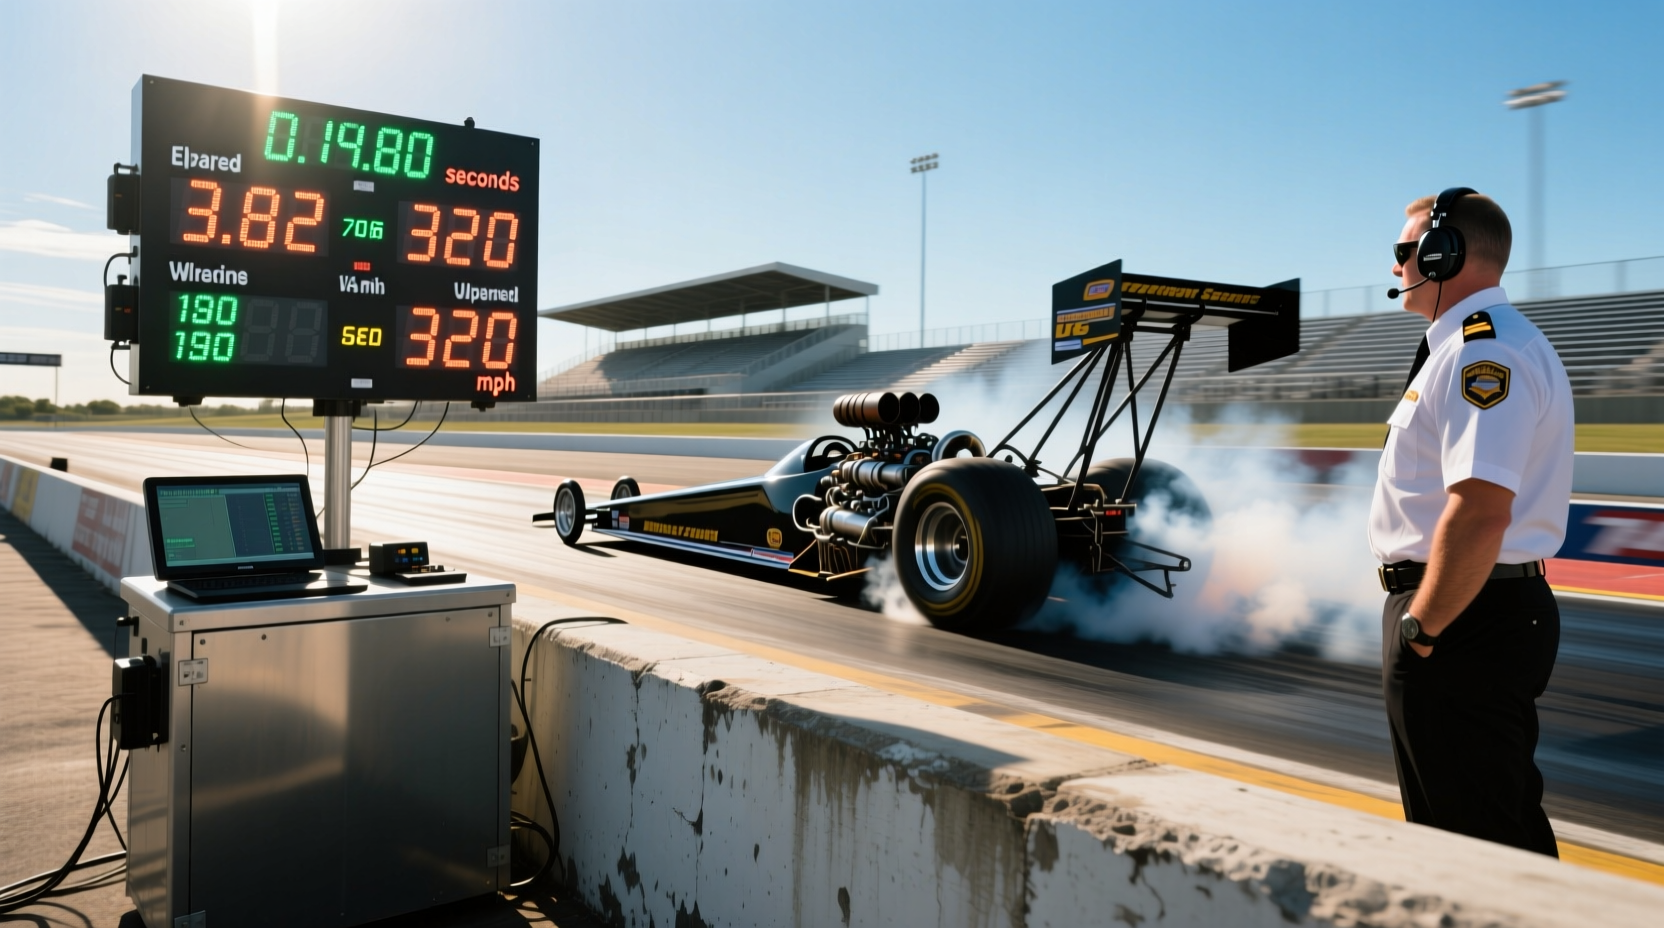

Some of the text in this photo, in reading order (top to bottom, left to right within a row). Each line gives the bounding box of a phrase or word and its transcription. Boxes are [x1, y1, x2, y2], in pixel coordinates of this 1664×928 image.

[445, 166, 520, 192] seconds
[183, 179, 324, 252] 3.82
[407, 203, 518, 268] 320
[179, 294, 238, 325] 190
[175, 331, 235, 362] 190
[406, 307, 517, 369] 320
[476, 371, 516, 396] mph
